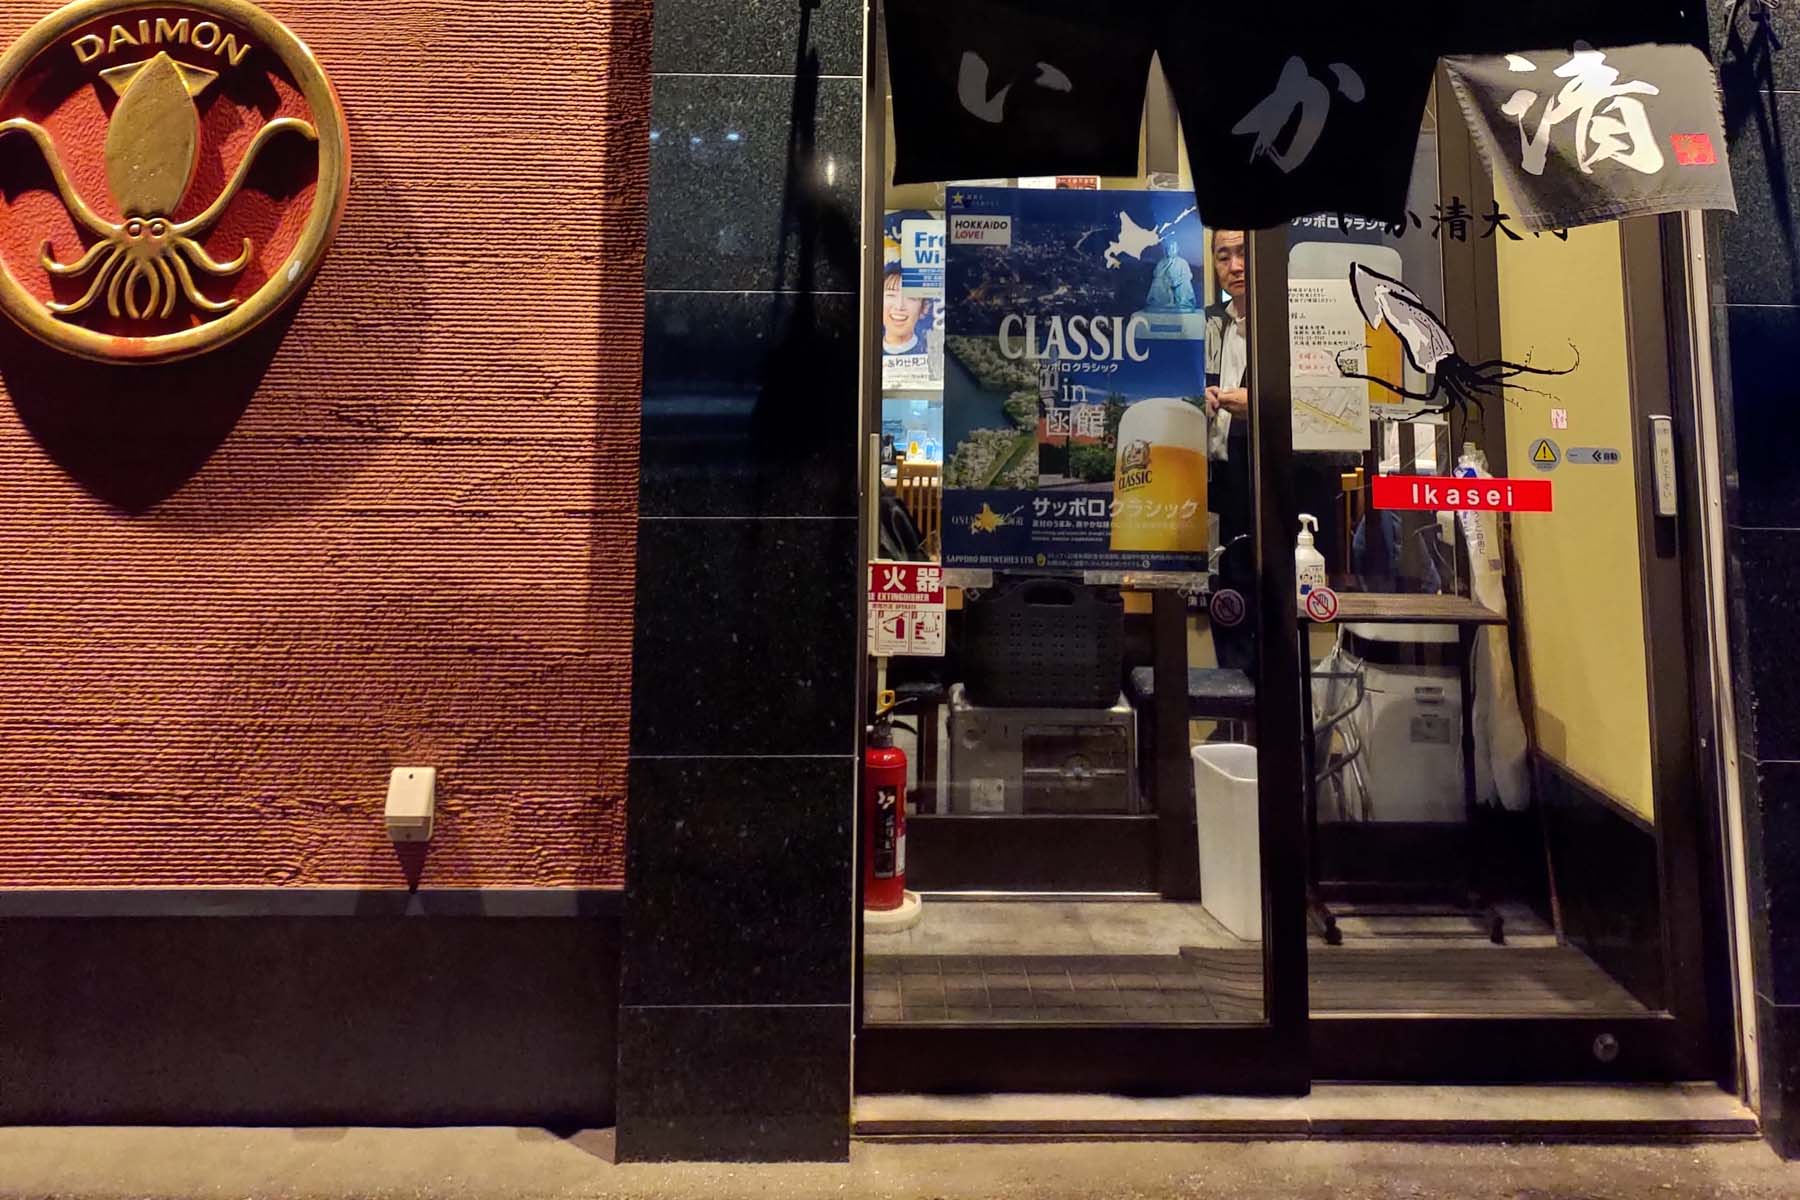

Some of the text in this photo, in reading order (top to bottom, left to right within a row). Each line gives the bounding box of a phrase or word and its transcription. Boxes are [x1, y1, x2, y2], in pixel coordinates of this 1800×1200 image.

[72, 18, 252, 66] DAIMON
[955, 231, 984, 241] LOVE!
[999, 314, 1150, 362] CLASSIC
[1033, 361, 1119, 373] サッポロクラシック
[1062, 378, 1088, 402] in
[1045, 406, 1107, 438] 函館
[1118, 470, 1153, 491] CLASSIC
[1411, 483, 1514, 507] Ikasei
[1032, 497, 1199, 519] サッポロクラシック
[868, 566, 940, 593] 火器
